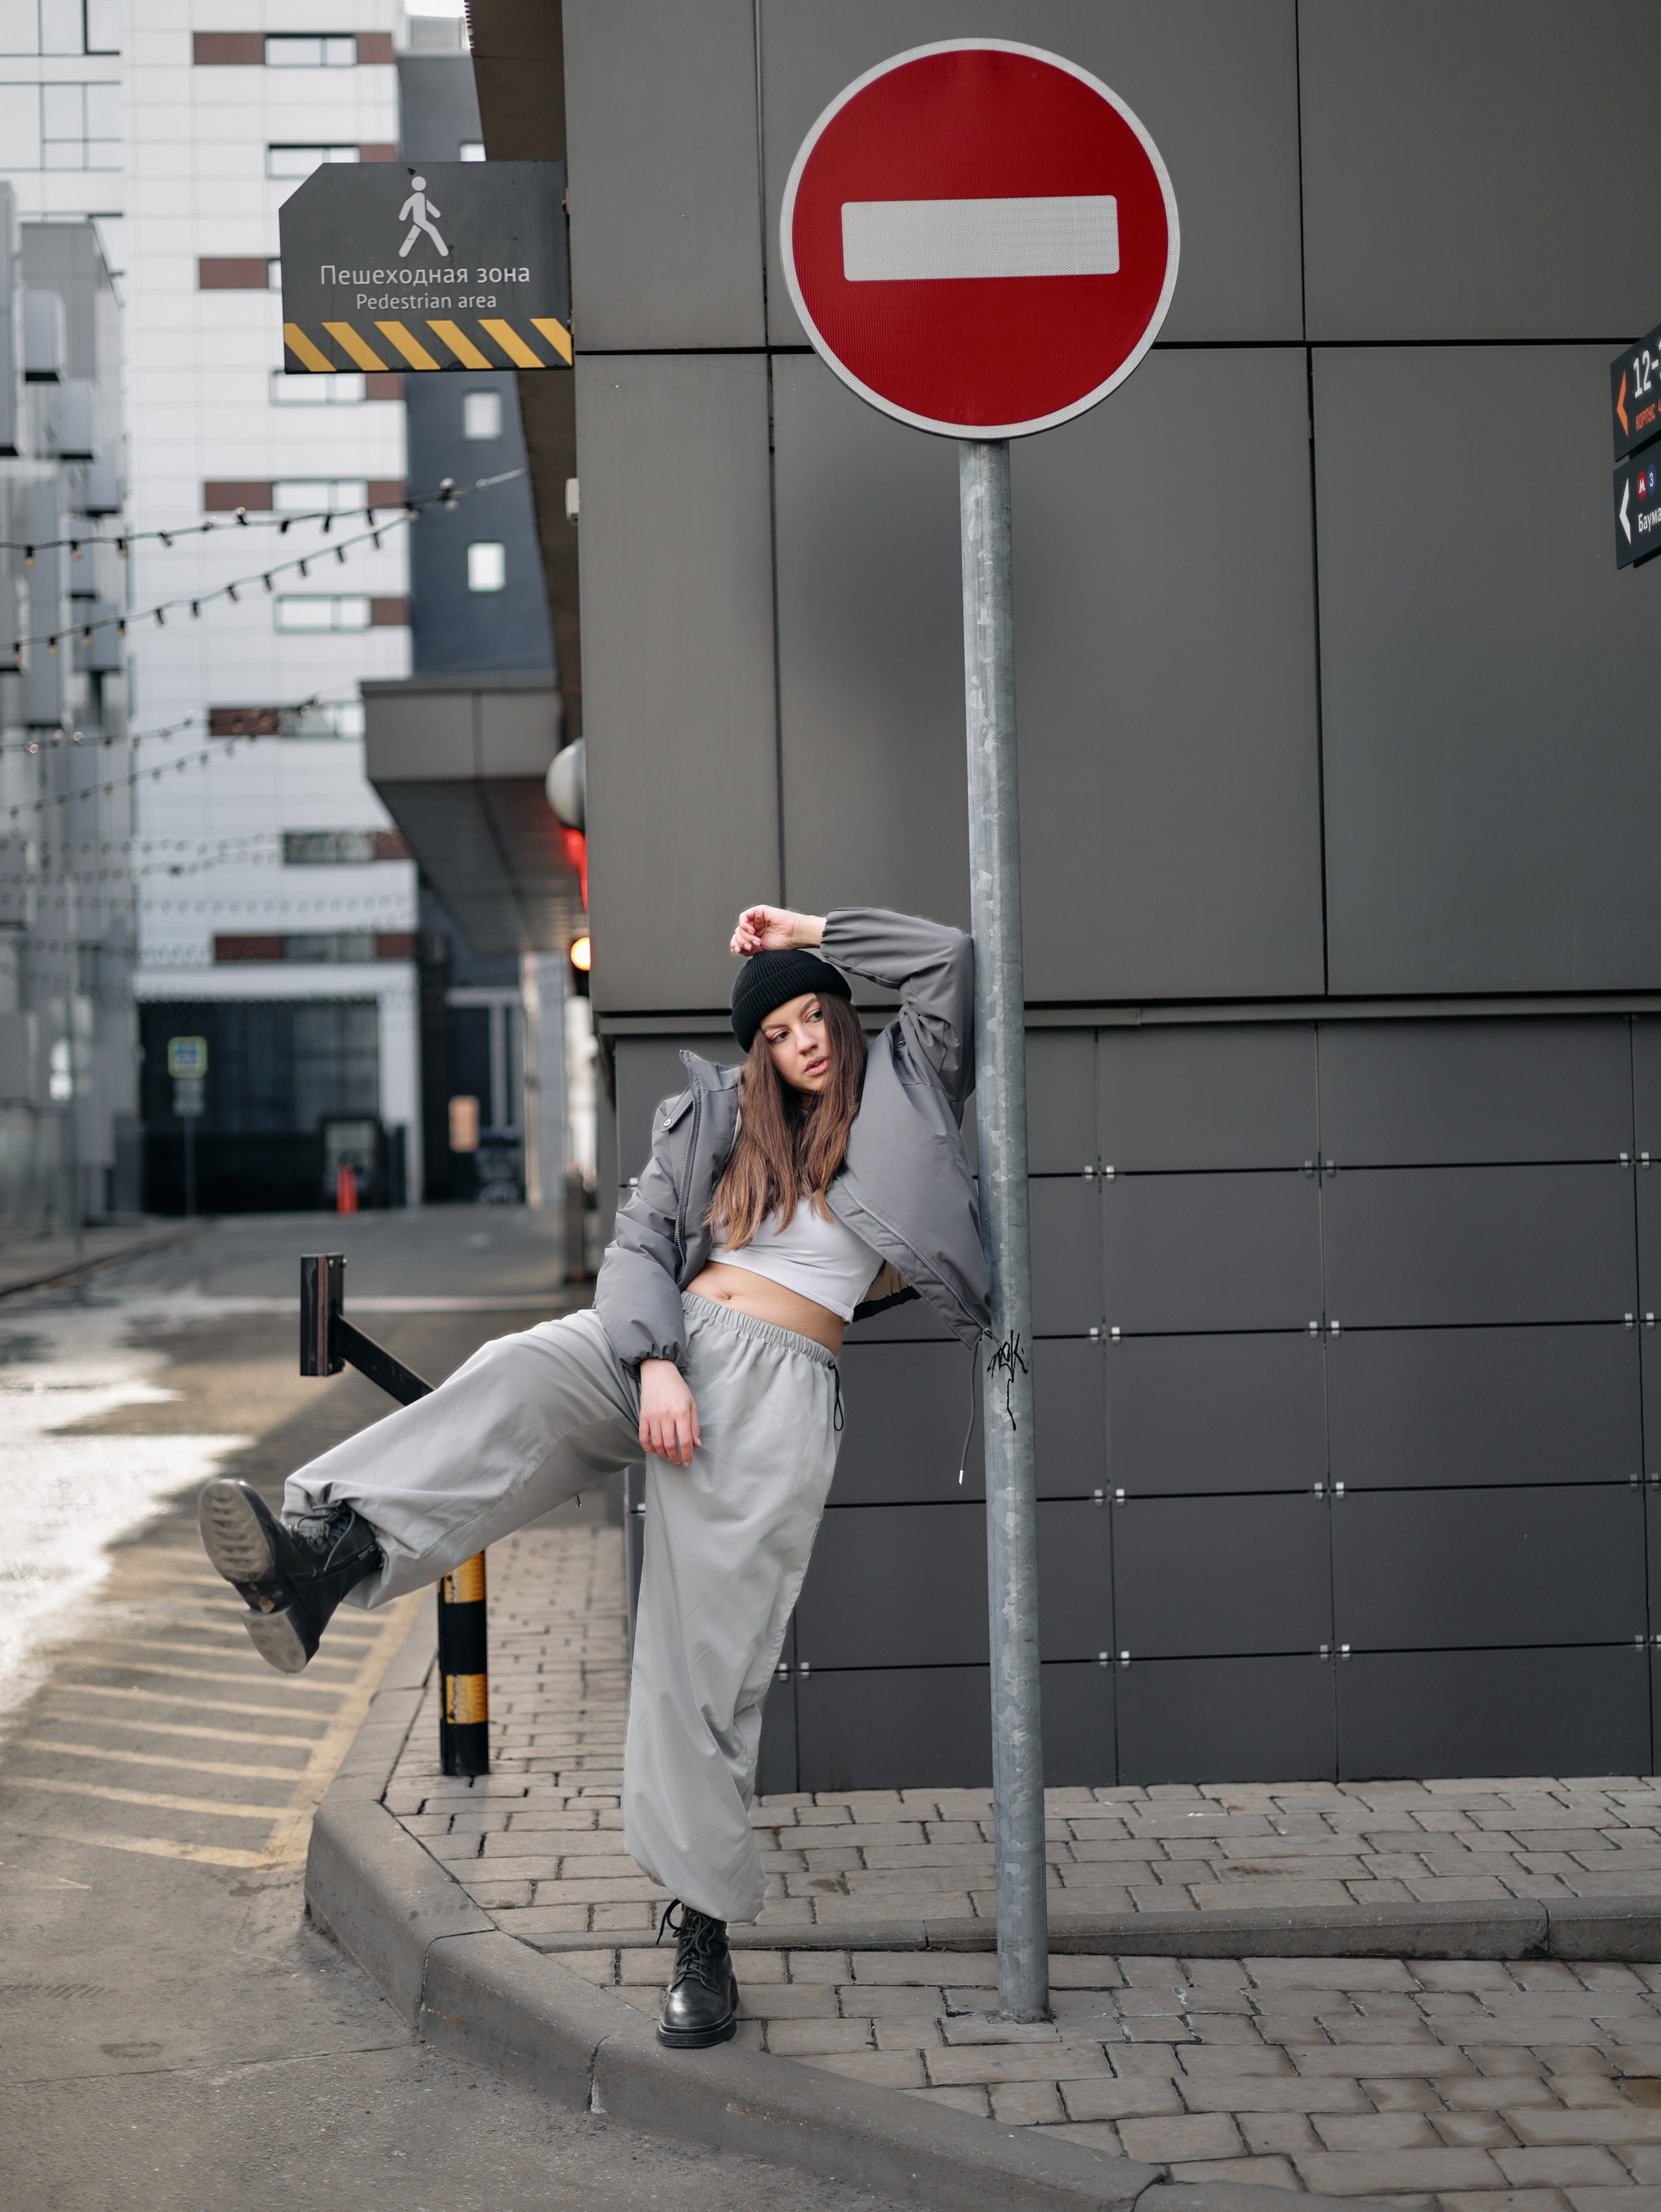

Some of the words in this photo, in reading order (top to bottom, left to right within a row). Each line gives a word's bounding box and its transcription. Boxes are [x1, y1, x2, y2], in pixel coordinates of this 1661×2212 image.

[321, 265, 468, 287] Пешеходная
[476, 267, 530, 283] зона
[357, 293, 452, 309] Pedestrian
[457, 296, 497, 308] area
[1633, 339, 1661, 398] 12-
[1649, 472, 1653, 487] 3
